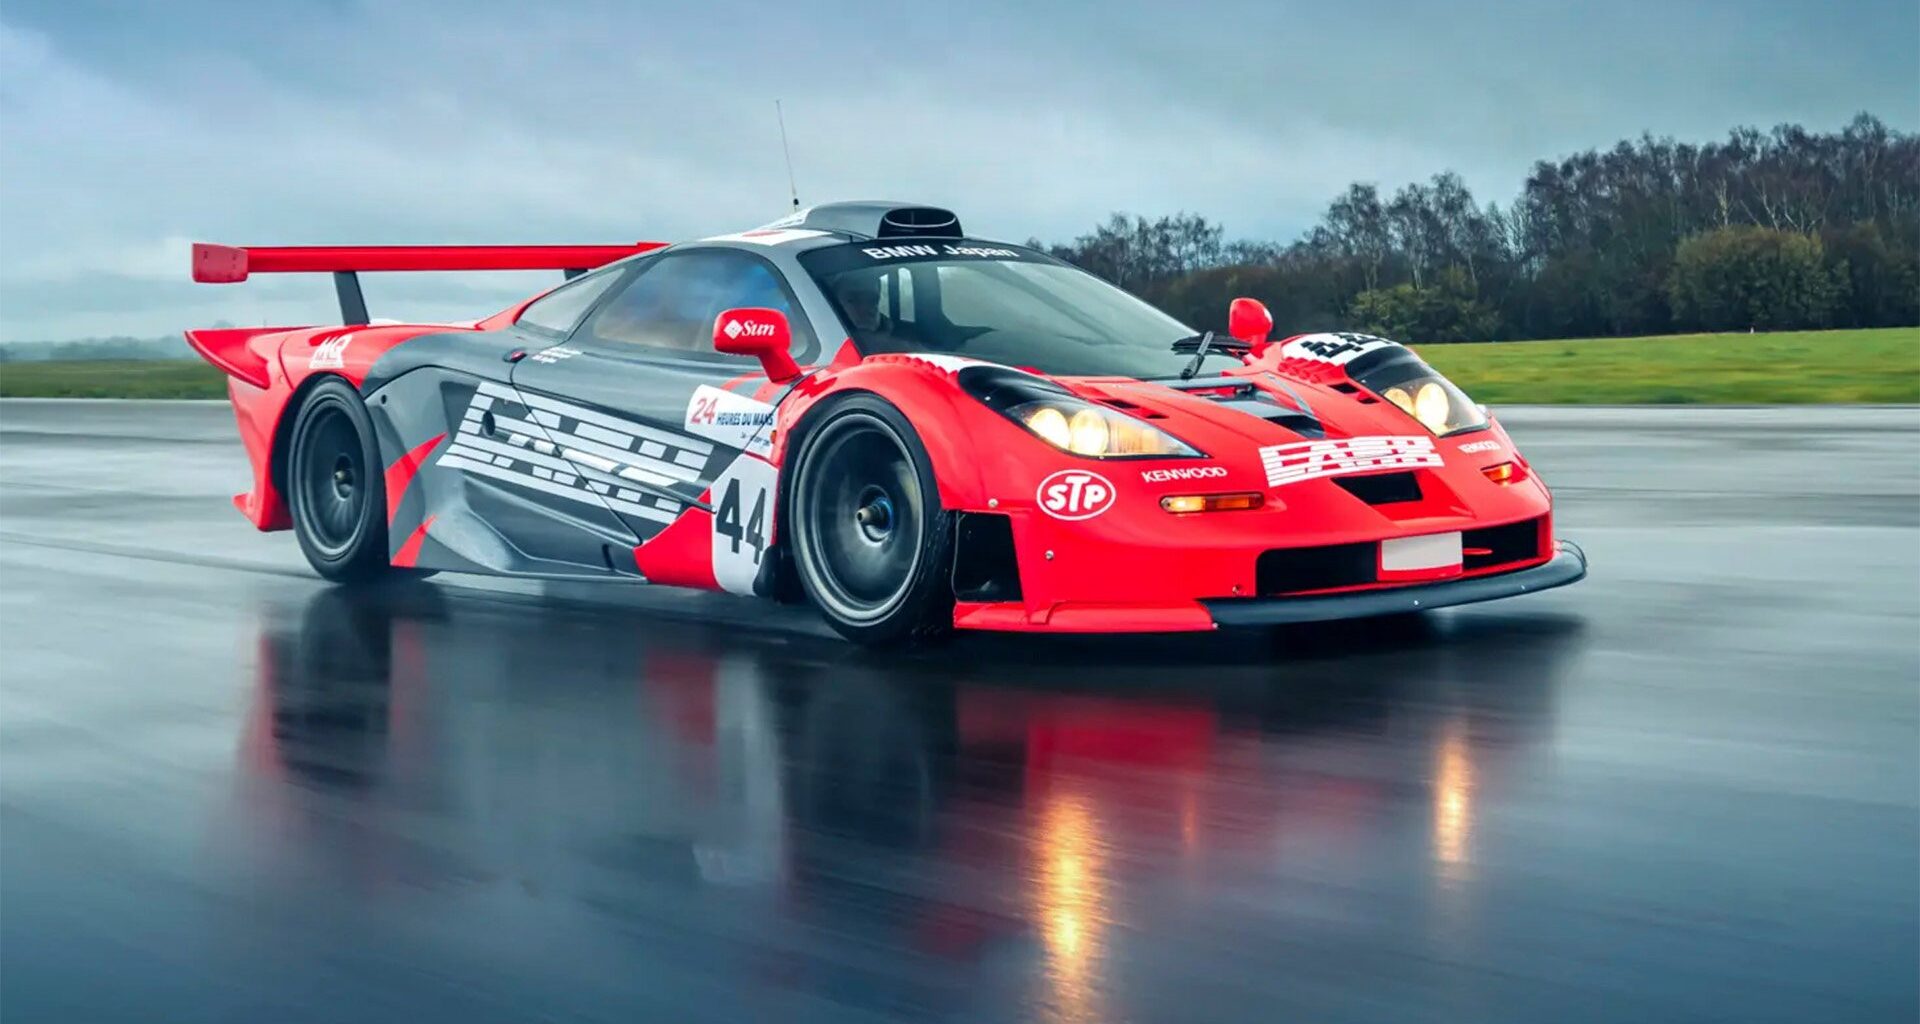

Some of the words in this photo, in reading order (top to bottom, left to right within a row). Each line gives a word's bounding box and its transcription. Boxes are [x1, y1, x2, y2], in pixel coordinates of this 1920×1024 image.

[862, 244, 939, 259] BMW
[943, 244, 1020, 258] Japan
[741, 320, 776, 336] Sun
[691, 398, 718, 424] 24
[717, 412, 740, 425] HEURES
[741, 412, 753, 426] DU
[753, 412, 774, 425] MANS
[1141, 467, 1228, 483] KENWOOD
[1046, 475, 1107, 512] STP
[716, 477, 766, 566] 44
